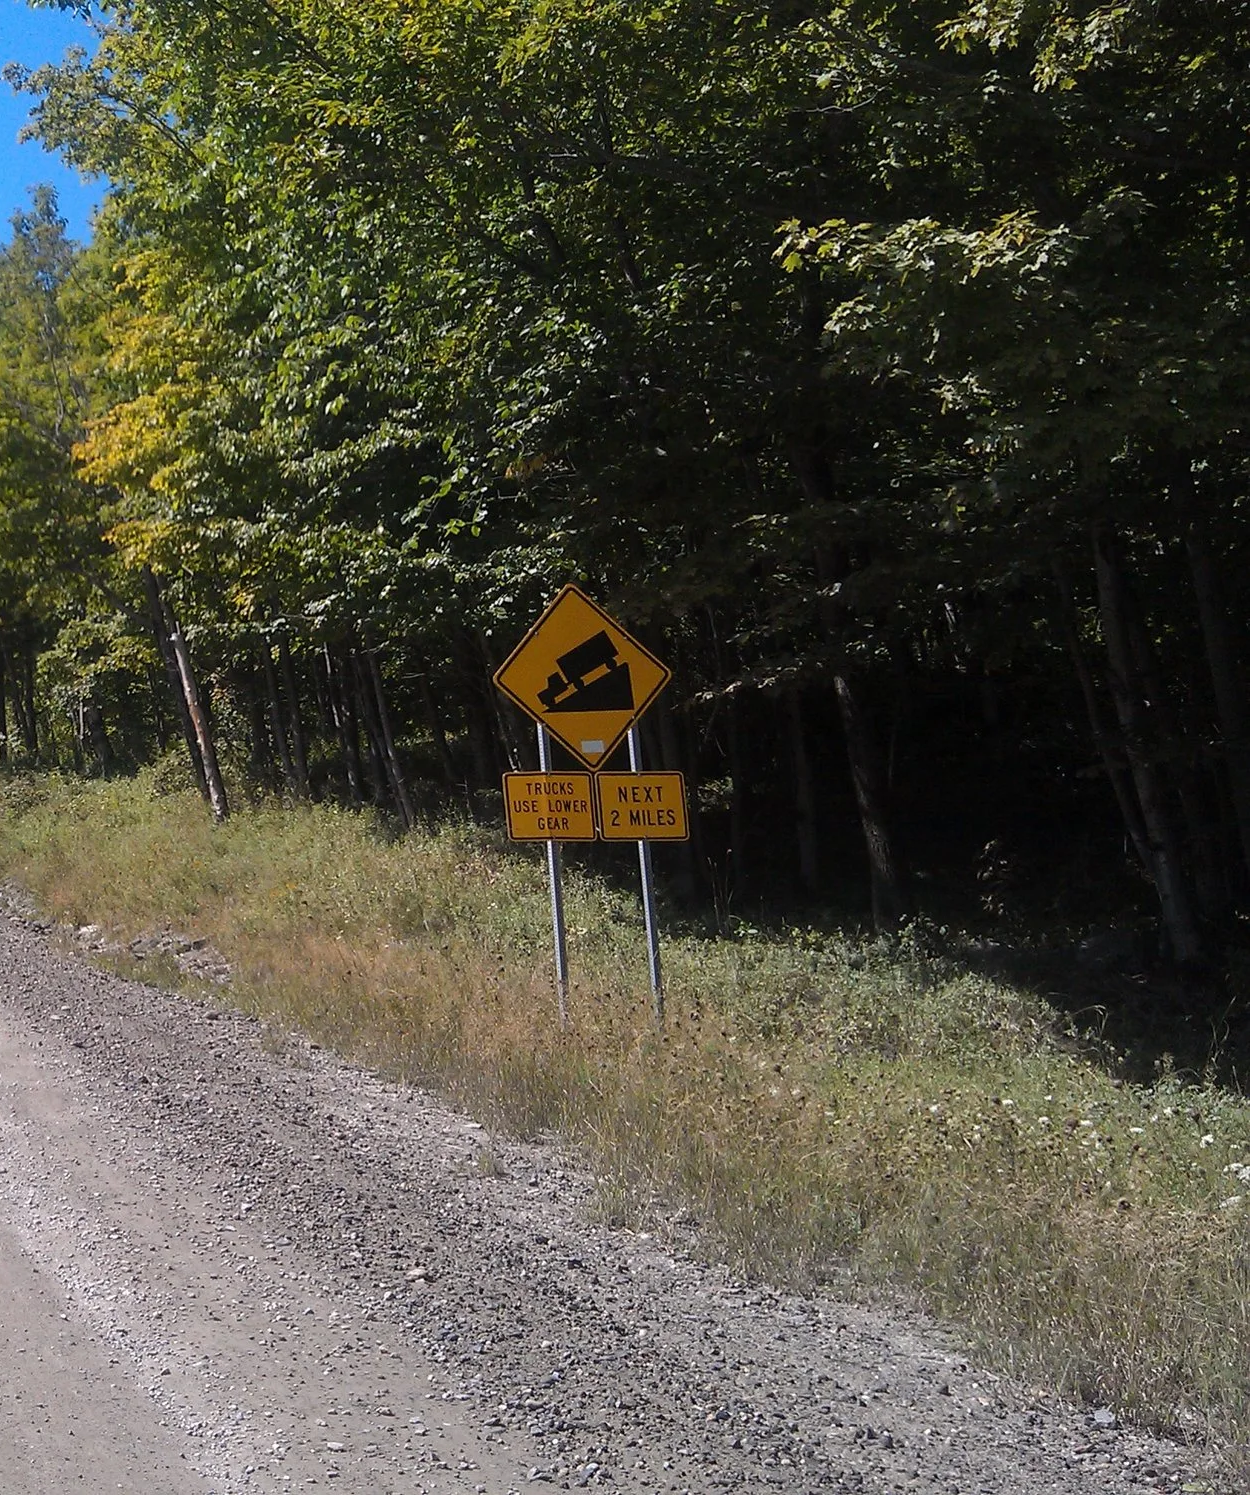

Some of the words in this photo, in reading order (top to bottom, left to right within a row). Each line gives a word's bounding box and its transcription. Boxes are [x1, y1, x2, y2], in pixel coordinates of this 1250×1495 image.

[526, 782, 574, 795] TRUCKS
[617, 786, 663, 803] NEXT
[513, 800, 538, 813] USE
[548, 800, 588, 813] LOWER
[537, 817, 569, 830] GEAR
[610, 810, 621, 826] 2
[629, 809, 676, 826] MILES
